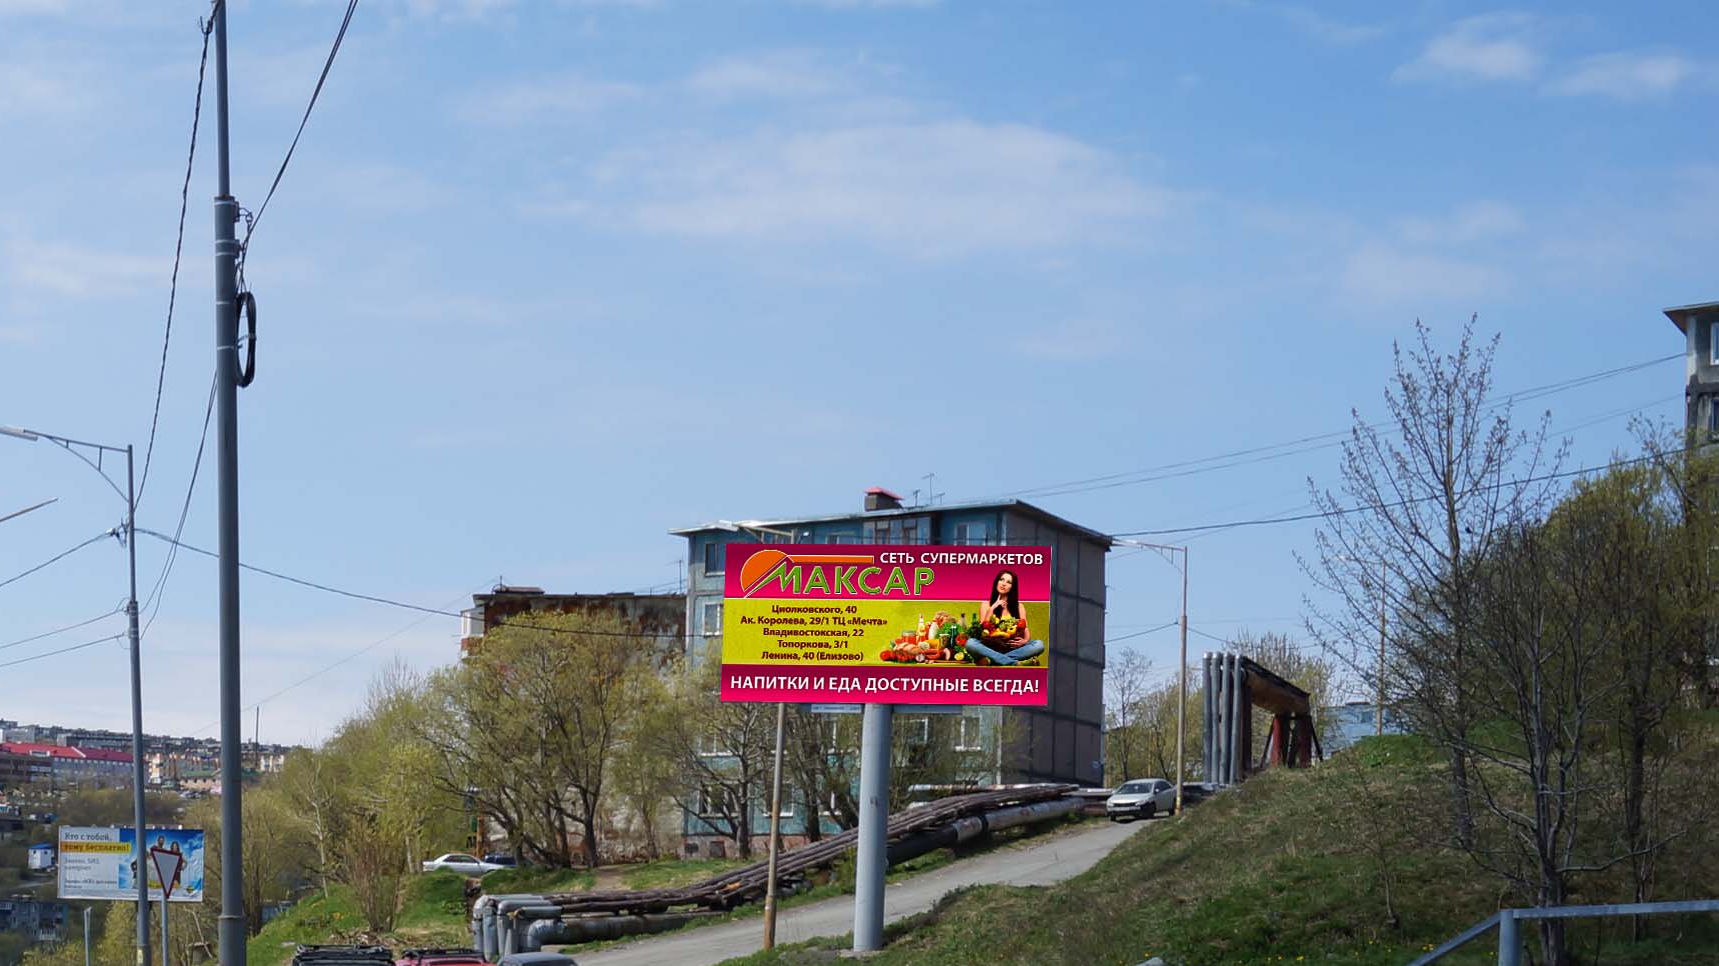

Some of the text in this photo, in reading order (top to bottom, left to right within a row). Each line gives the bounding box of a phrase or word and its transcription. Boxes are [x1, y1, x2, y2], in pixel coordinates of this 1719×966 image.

[880, 552, 1044, 566] СЕТЬ СУПЕРМАРКЕТОВ
[743, 561, 936, 598] МАКСАР
[771, 605, 857, 614] Циолковского, 40
[740, 616, 888, 626] Ак. Королева, 29/1 ТЦ «Мечта»
[763, 628, 864, 637] Владивостокская, 22
[777, 640, 848, 649] Топоркова, 3/1
[761, 652, 864, 661] Ленина, 40 (Елизово)
[730, 676, 1039, 695] НАПИТКИ И ЕДА ДОСТУПНЫЕ ВСЕГДА!
